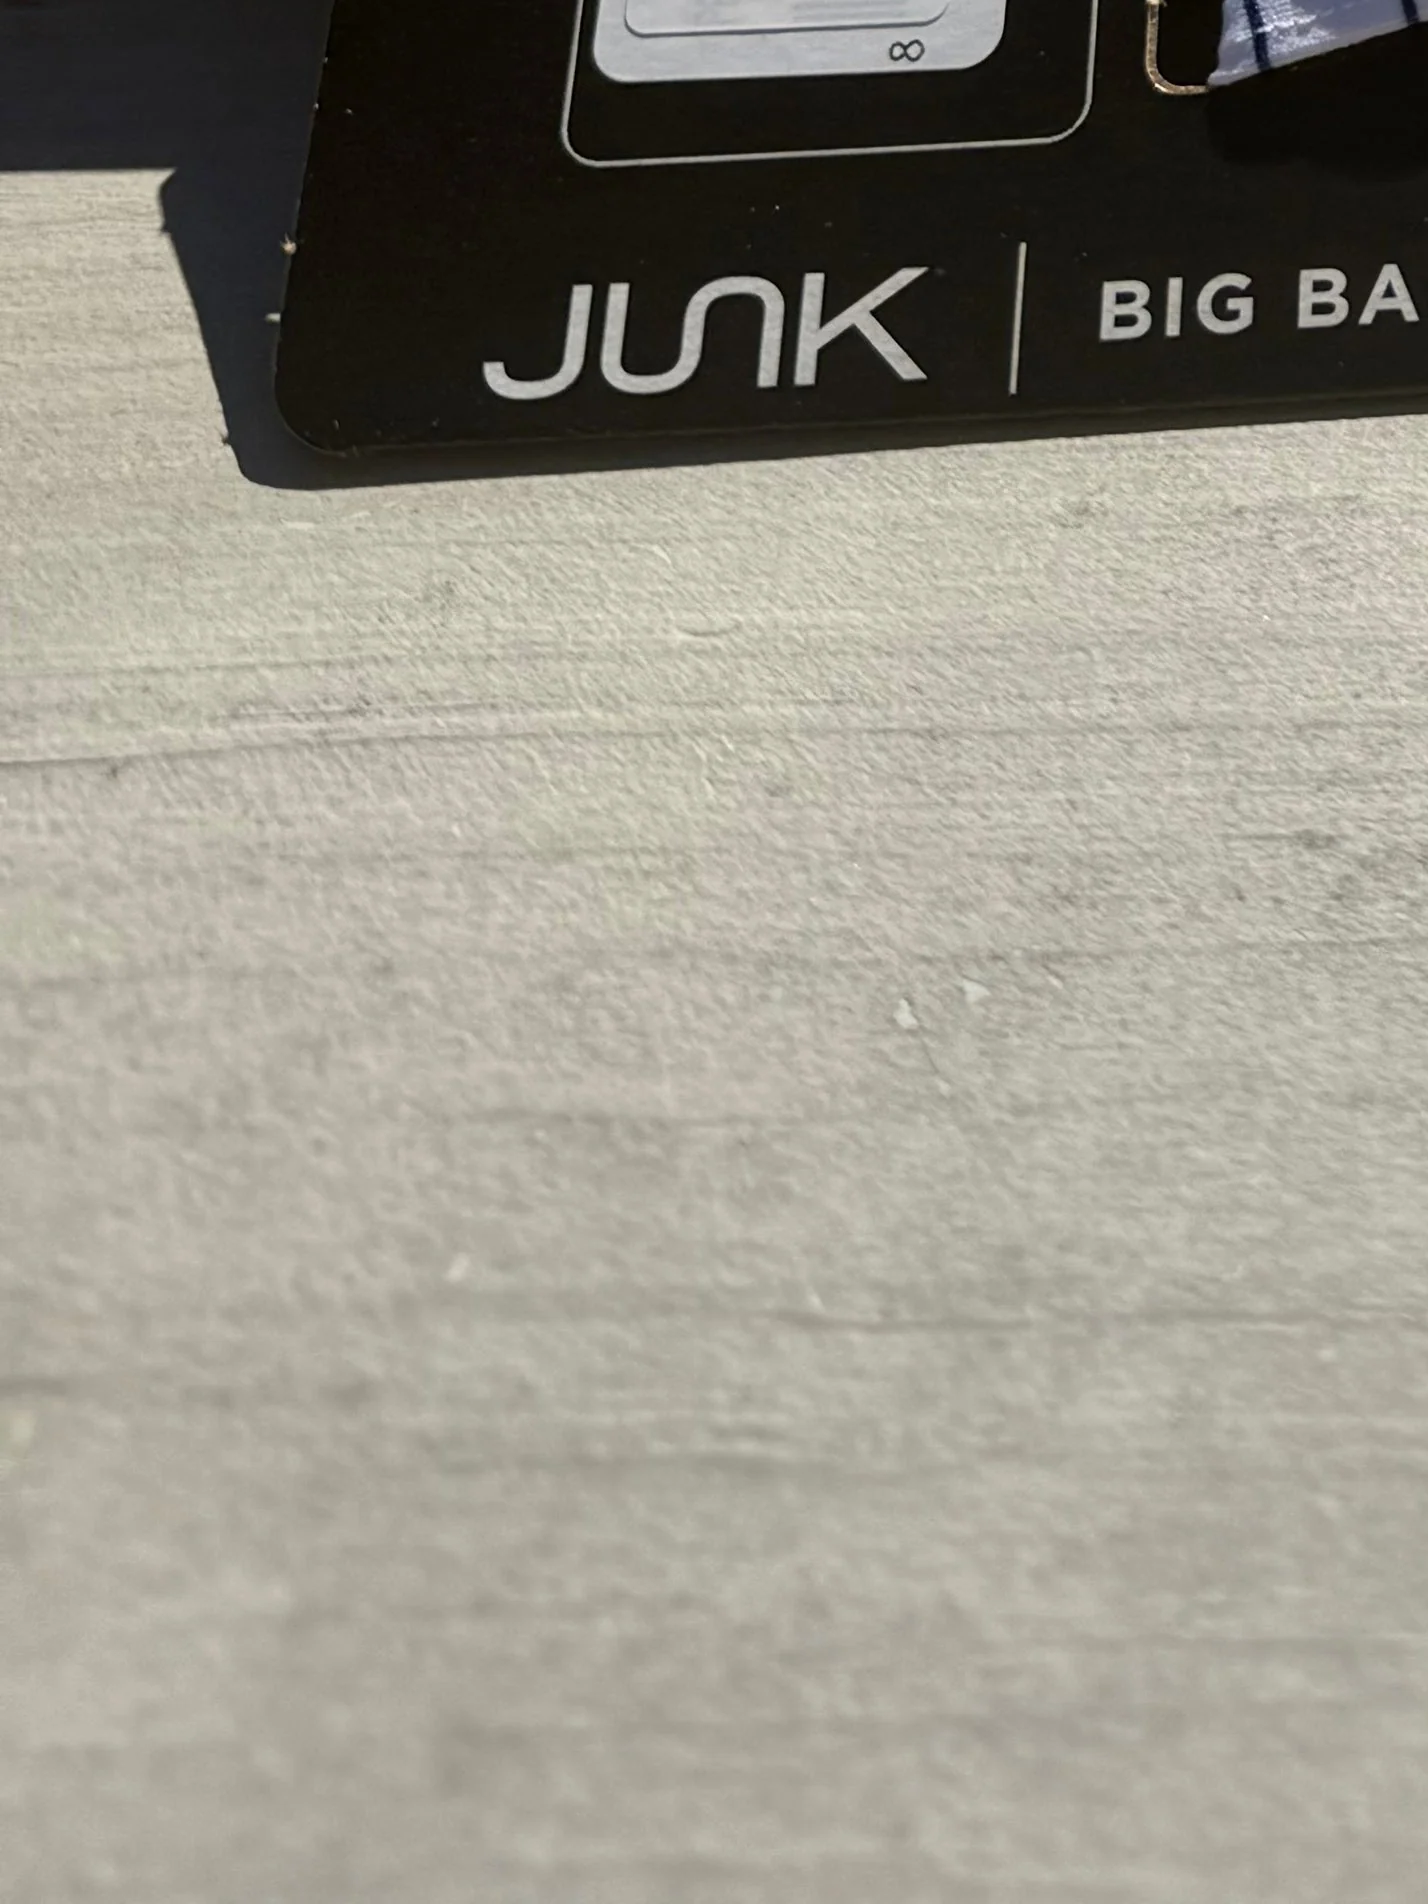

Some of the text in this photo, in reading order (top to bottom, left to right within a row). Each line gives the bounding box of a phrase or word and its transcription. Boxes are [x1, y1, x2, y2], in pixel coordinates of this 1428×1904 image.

[889, 38, 926, 64] 8
[481, 265, 930, 402] JUNK
[1098, 272, 1255, 343] BIG
